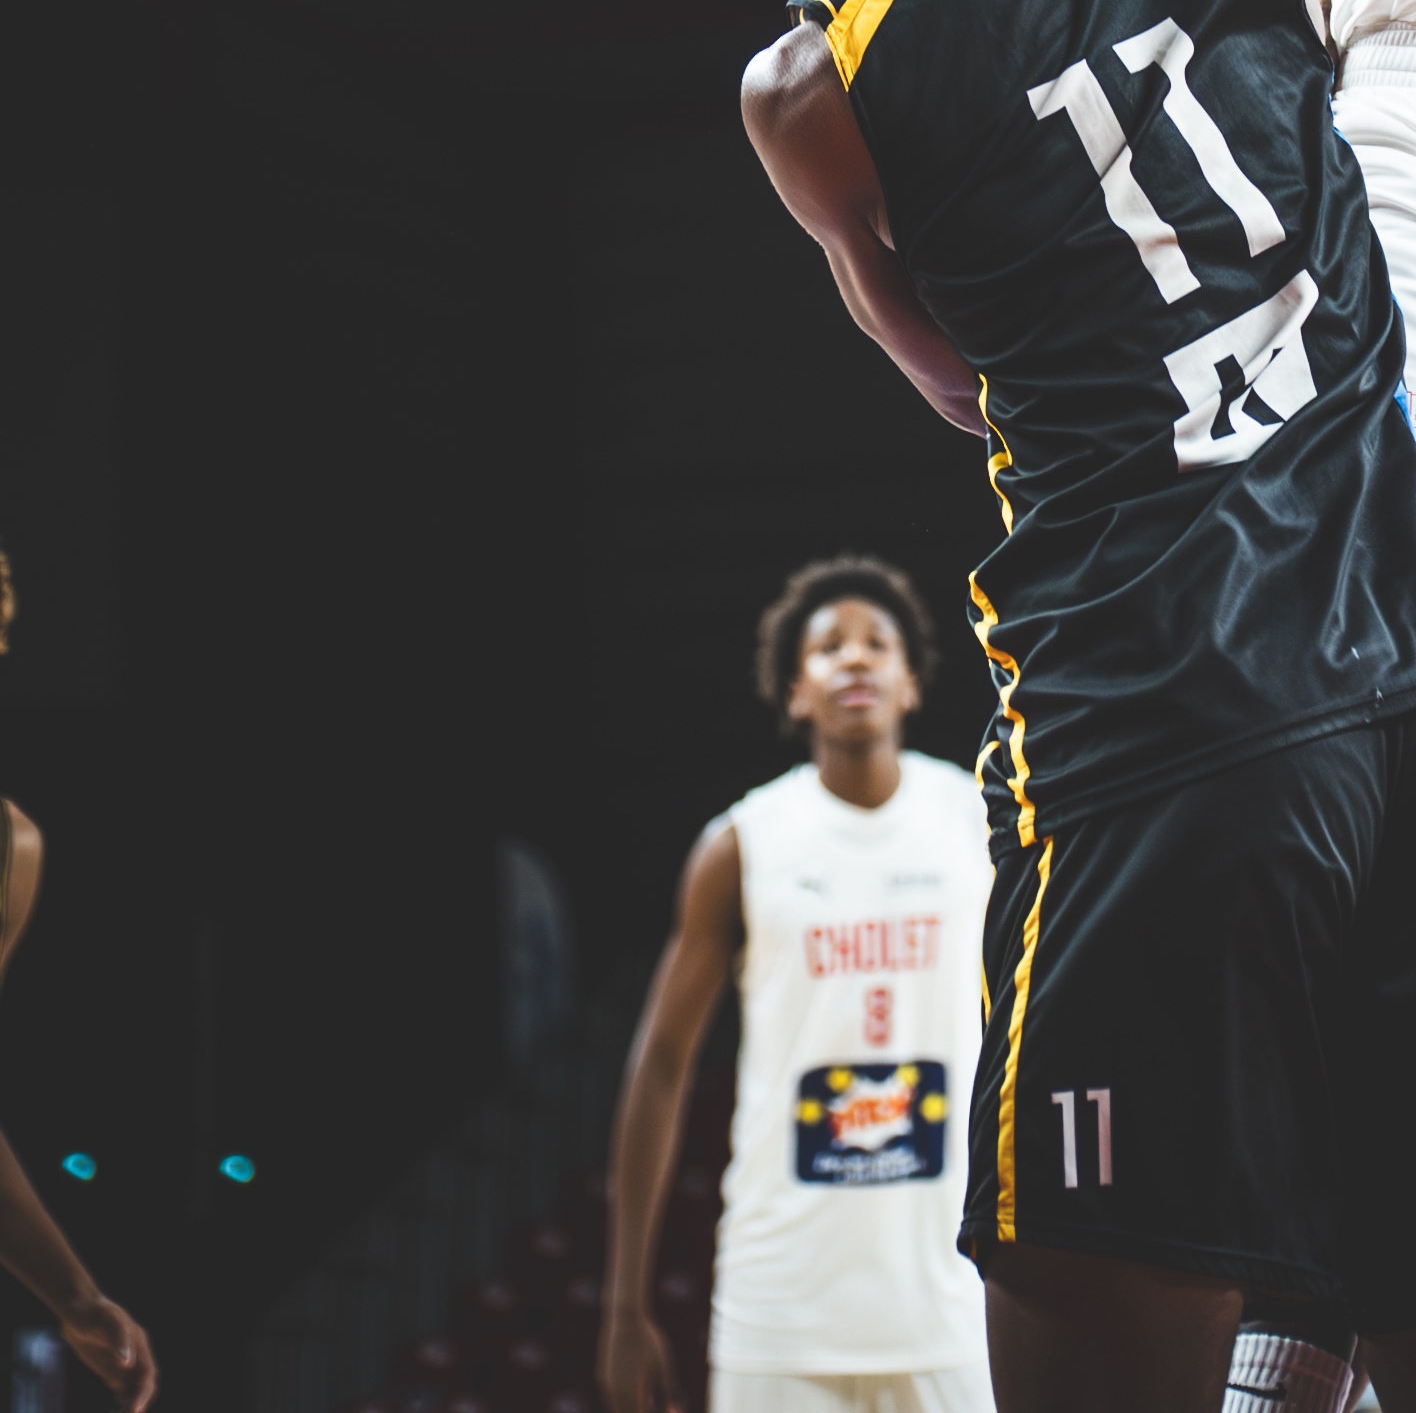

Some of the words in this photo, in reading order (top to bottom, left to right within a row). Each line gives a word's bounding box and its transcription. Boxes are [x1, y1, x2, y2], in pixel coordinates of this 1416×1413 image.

[1026, 16, 1287, 305] 11
[804, 914, 942, 979] CHOLET
[1051, 1087, 1113, 1189] 11
